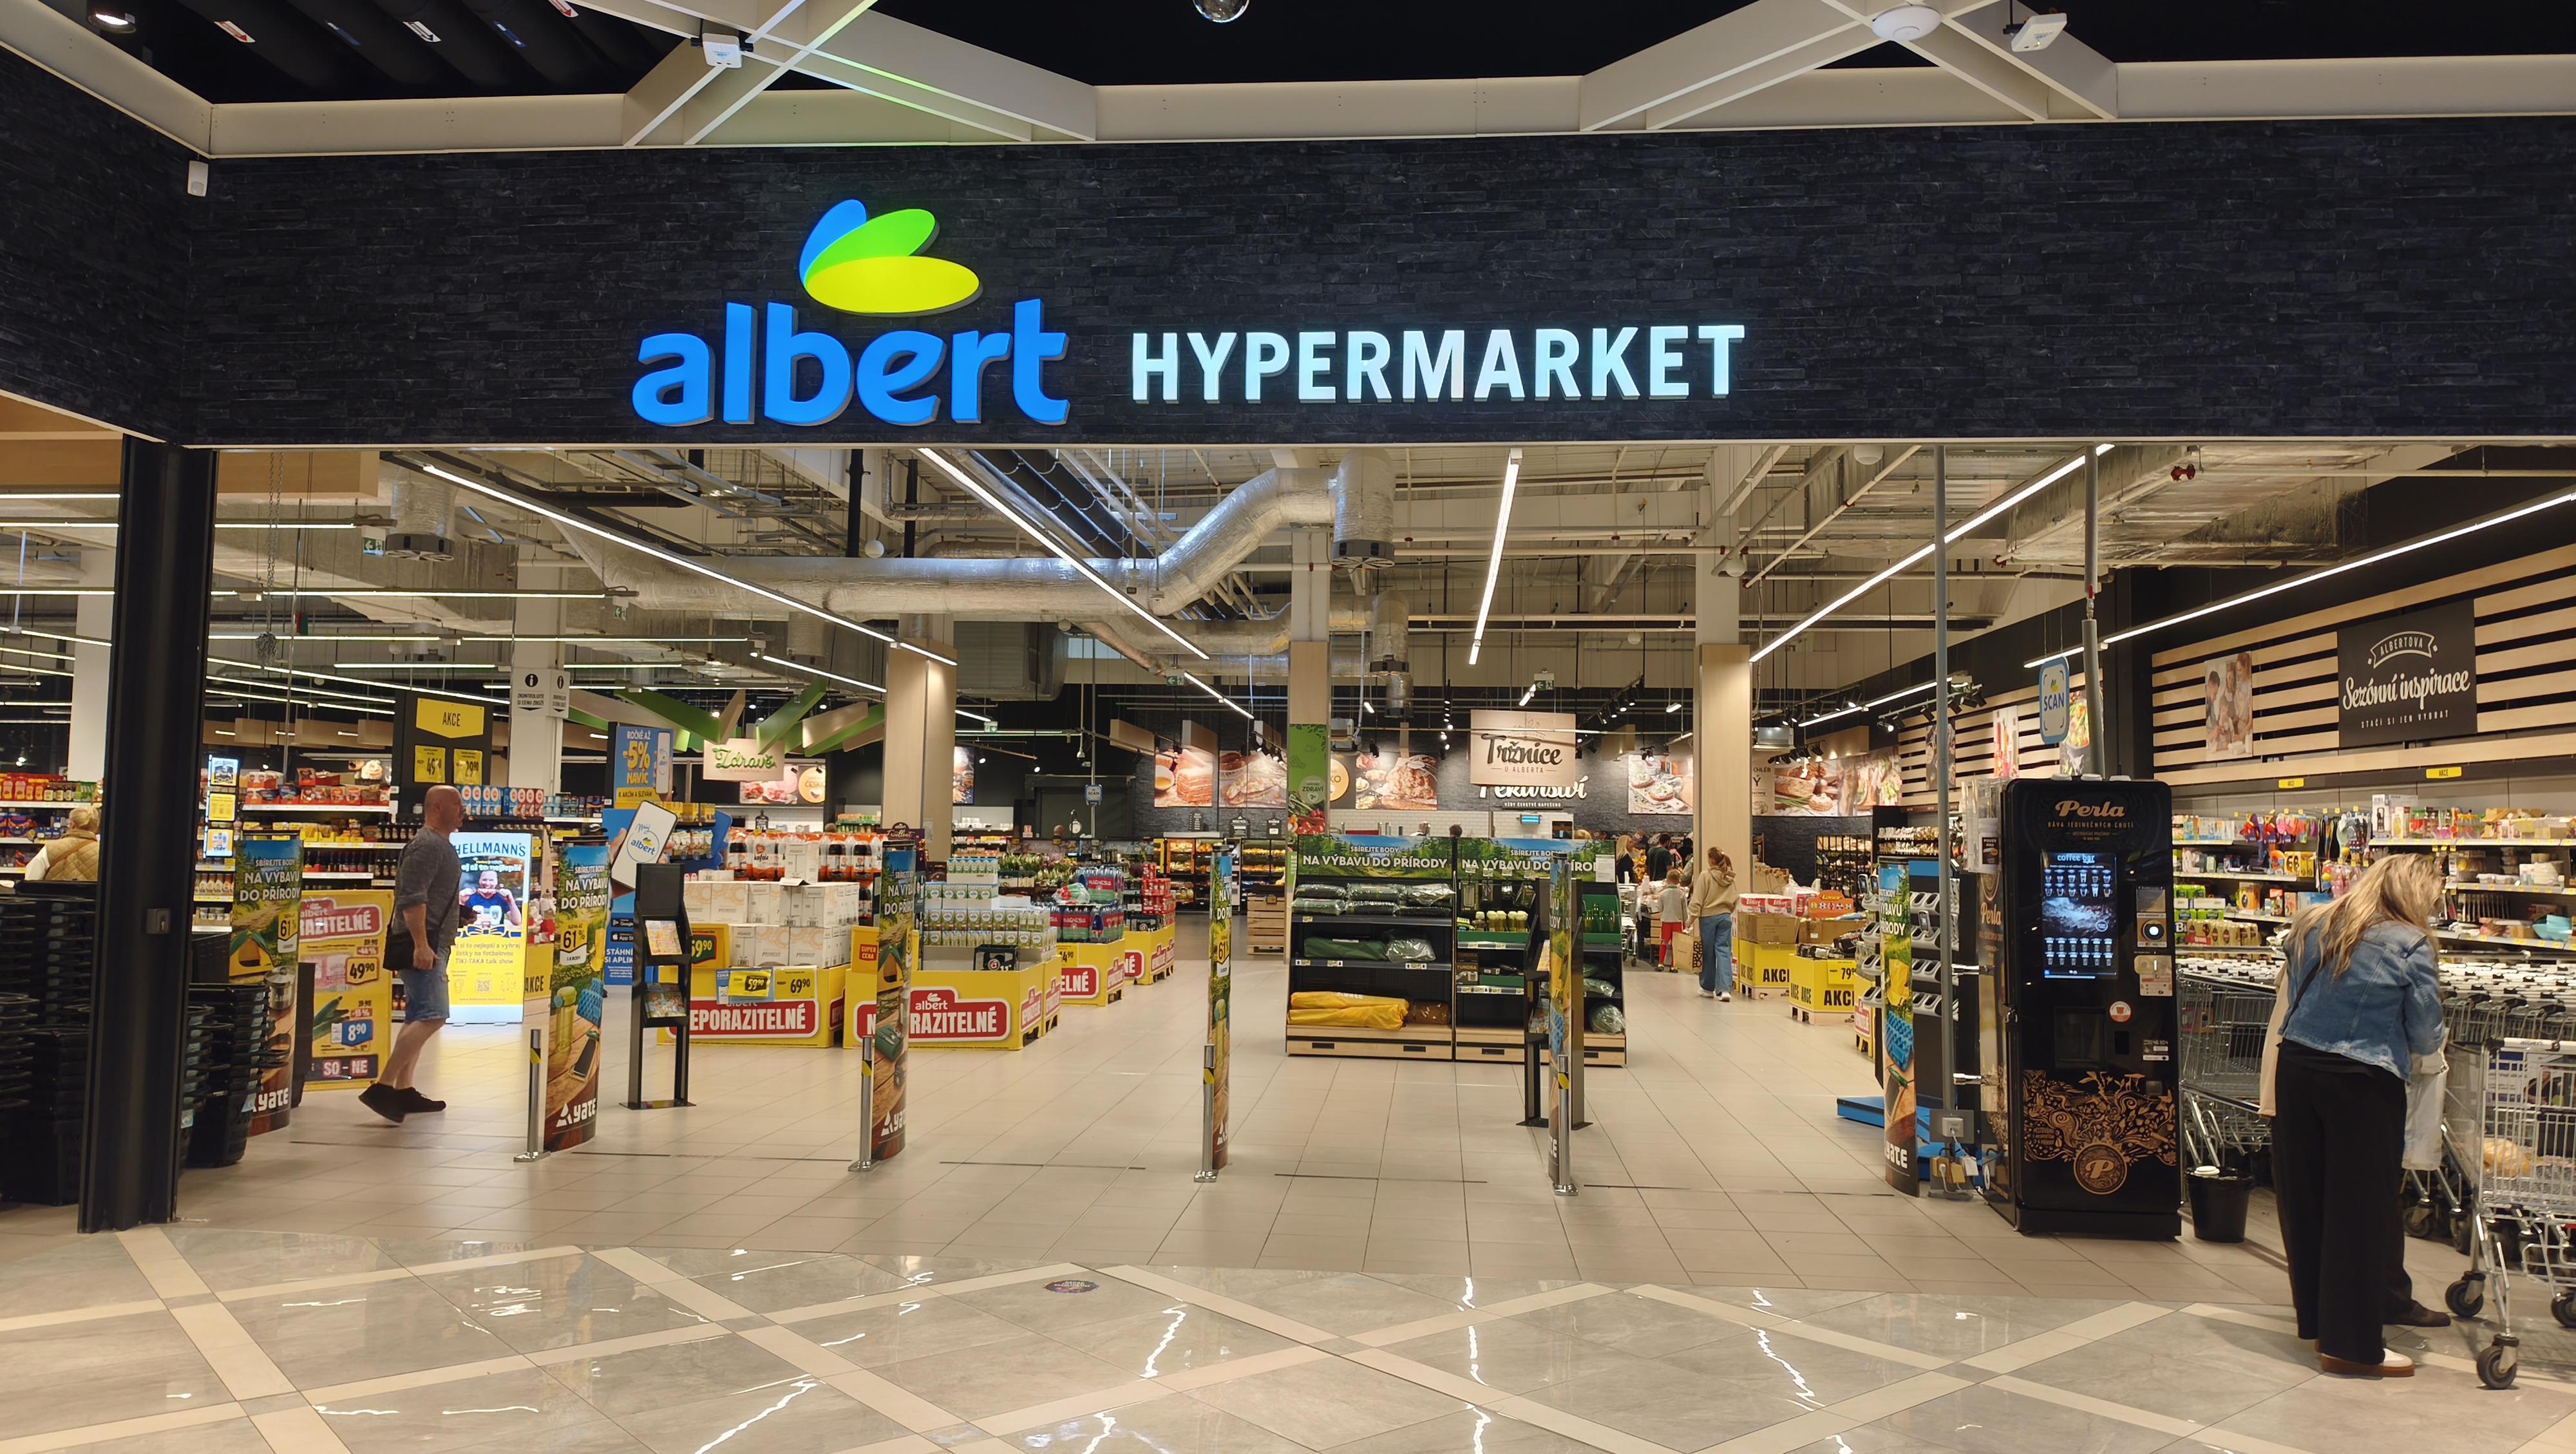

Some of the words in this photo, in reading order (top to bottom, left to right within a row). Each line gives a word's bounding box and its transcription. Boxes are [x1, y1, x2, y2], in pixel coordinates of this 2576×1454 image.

[632, 299, 1070, 426] albert
[1132, 325, 1745, 404] HYPERMARKET
[2380, 636, 2423, 657] ALBERTOVA
[2342, 673, 2398, 710] Sezónní
[2400, 667, 2471, 710] inspirace
[2043, 692, 2065, 712] SCAN
[442, 712, 460, 726] AKCE
[2361, 717, 2383, 729] STAČÍ
[2387, 717, 2395, 726] SI
[2400, 714, 2413, 724] JEN
[2418, 709, 2449, 721] VYBRAT
[623, 741, 650, 771] -5%
[1481, 733, 1563, 766] Tržnice
[2055, 800, 2125, 817] Perla
[630, 838, 656, 855] albert
[1350, 845, 1379, 853] SBÍREJTE
[1510, 847, 1540, 856] SBÍREJTE
[1303, 855, 1320, 865] NA
[1321, 853, 1370, 867] VÝBAVU
[1372, 857, 1391, 867] DO
[1394, 855, 1448, 869] PŘÍRODY
[1462, 859, 1479, 869] NA
[1481, 857, 1530, 871] VÝBAVU
[1533, 860, 1551, 871] DO
[2082, 854, 2096, 864] bar
[245, 873, 262, 884] NA
[566, 879, 580, 892] NA
[240, 889, 260, 902] DO
[262, 885, 301, 901] PŘÍRODY
[888, 885, 899, 897] NA
[562, 897, 578, 909] DO
[884, 902, 898, 915] DO
[1980, 902, 2002, 926] Perla
[563, 930, 576, 949] 61
[606, 947, 633, 956] STÁHN
[525, 975, 544, 993] AKCE
[915, 1000, 948, 1010] albert
[1824, 990, 1855, 1006] AKC
[690, 1003, 806, 1030] EPORAZITELNÉ
[323, 1061, 340, 1076] SO
[351, 1059, 368, 1074] NE
[2085, 1159, 2115, 1179] P
